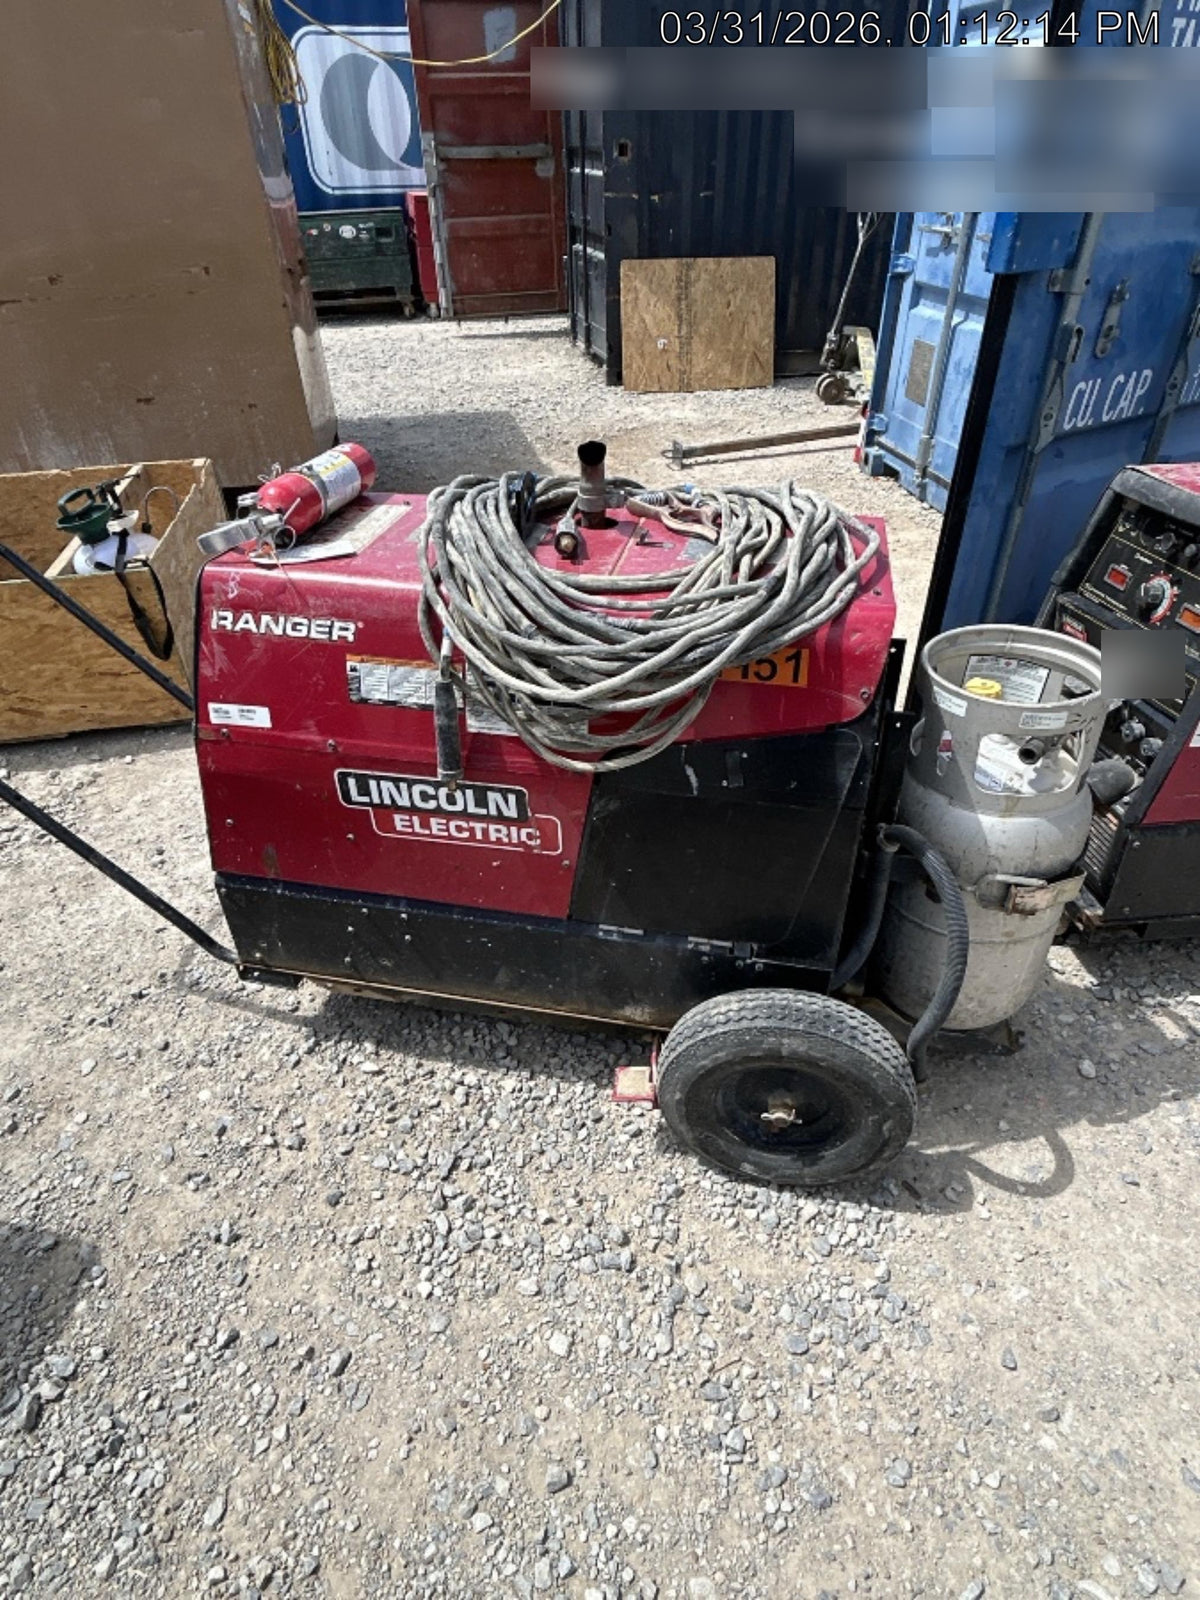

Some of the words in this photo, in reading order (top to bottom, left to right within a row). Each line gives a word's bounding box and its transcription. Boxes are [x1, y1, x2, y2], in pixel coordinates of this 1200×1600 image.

[1063, 378, 1101, 431] CU.
[1102, 368, 1153, 422] CAP.
[347, 776, 520, 819] LINCOLN
[392, 813, 541, 847] ELECTRIC
